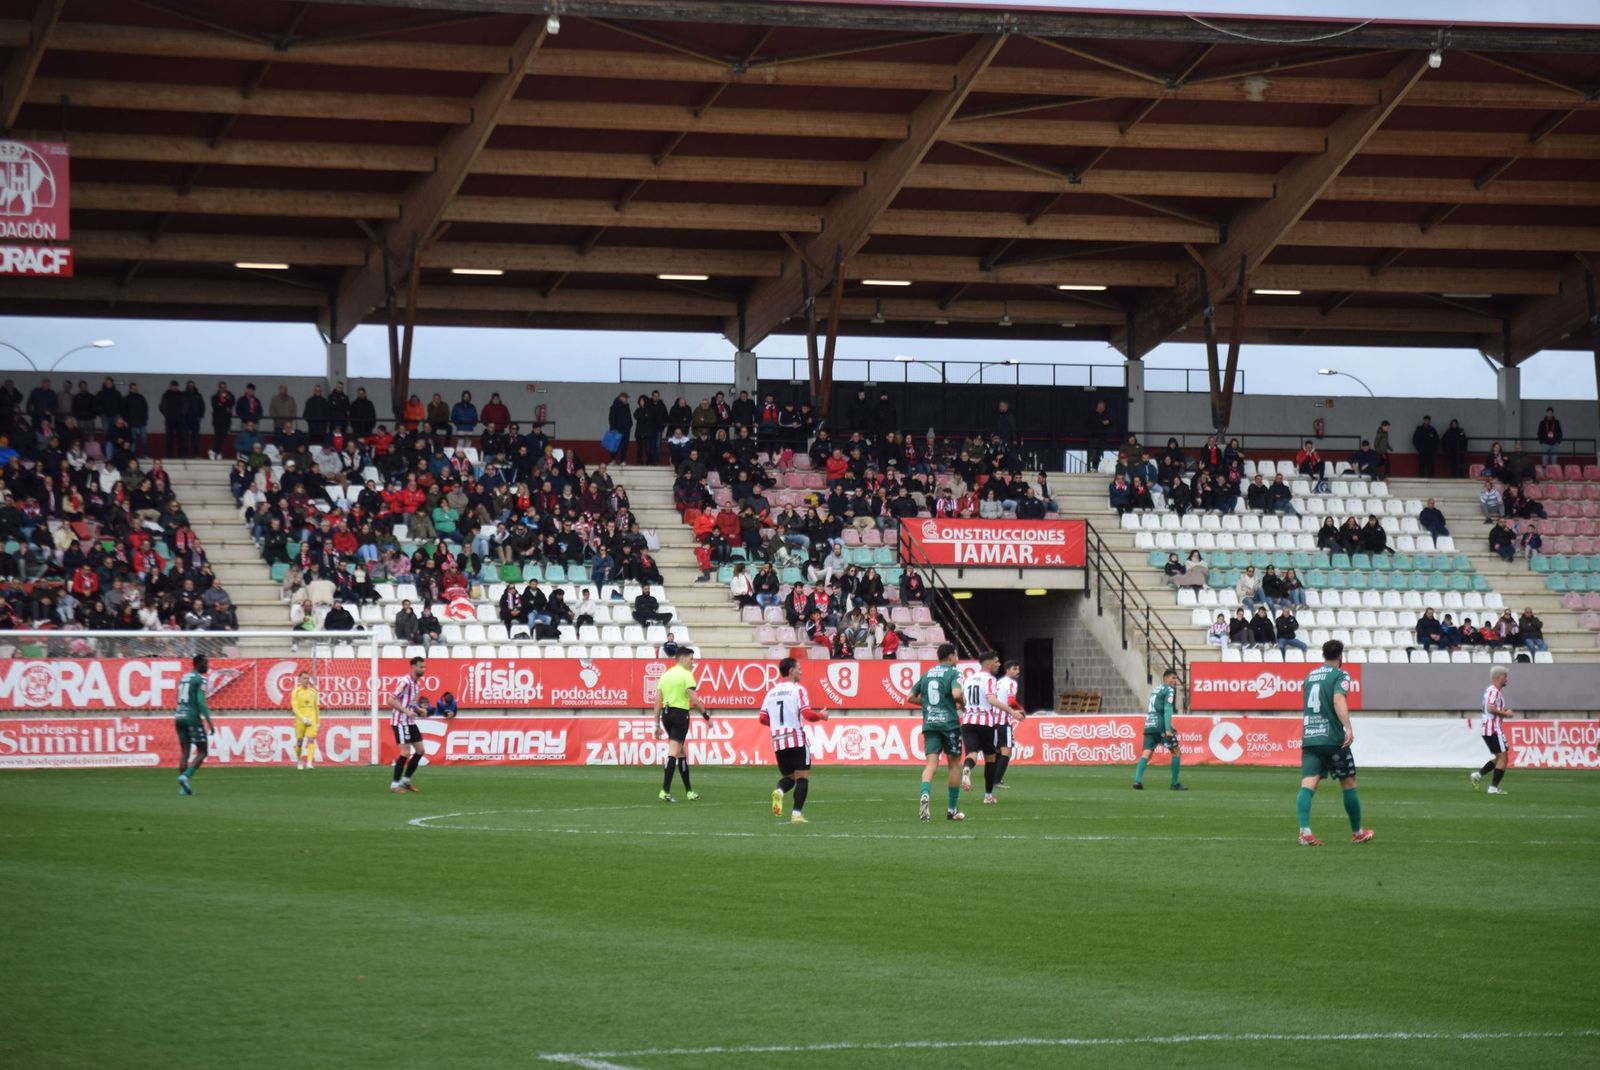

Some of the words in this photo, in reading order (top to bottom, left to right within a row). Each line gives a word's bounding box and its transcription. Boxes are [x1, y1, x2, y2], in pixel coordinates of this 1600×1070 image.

[922, 520, 1065, 541] CONSTRUCCIONES
[1045, 554, 1065, 564] S.A.
[118, 661, 181, 707] CF
[278, 676, 361, 691] CNTRO
[367, 676, 440, 692] OPTCO
[475, 662, 535, 690] fisio
[691, 663, 781, 692] AMOR
[838, 667, 851, 690] 8
[900, 667, 913, 690] 8
[551, 686, 628, 705] podoactiva
[698, 696, 755, 705] NTAMIENTO
[820, 678, 843, 705] ZAMORA
[882, 678, 905, 705] ZAMORA
[928, 680, 940, 705] 6
[967, 685, 980, 706] 10
[1307, 684, 1321, 713] 4
[777, 701, 784, 725] 7
[21, 724, 79, 736] bodegas
[1039, 720, 1136, 739] Escuela
[1246, 733, 1268, 742] COPE
[1512, 724, 1598, 745] FUNDACIÓ
[0, 728, 154, 754] Sumiller
[446, 730, 568, 754] FRIMAY
[1043, 742, 1136, 761] infantil
[1247, 742, 1284, 752] ZAMORA
[1288, 740, 1303, 749] COP
[586, 742, 736, 765] ZAMORNAS
[1514, 746, 1600, 767] ZAMORAC
